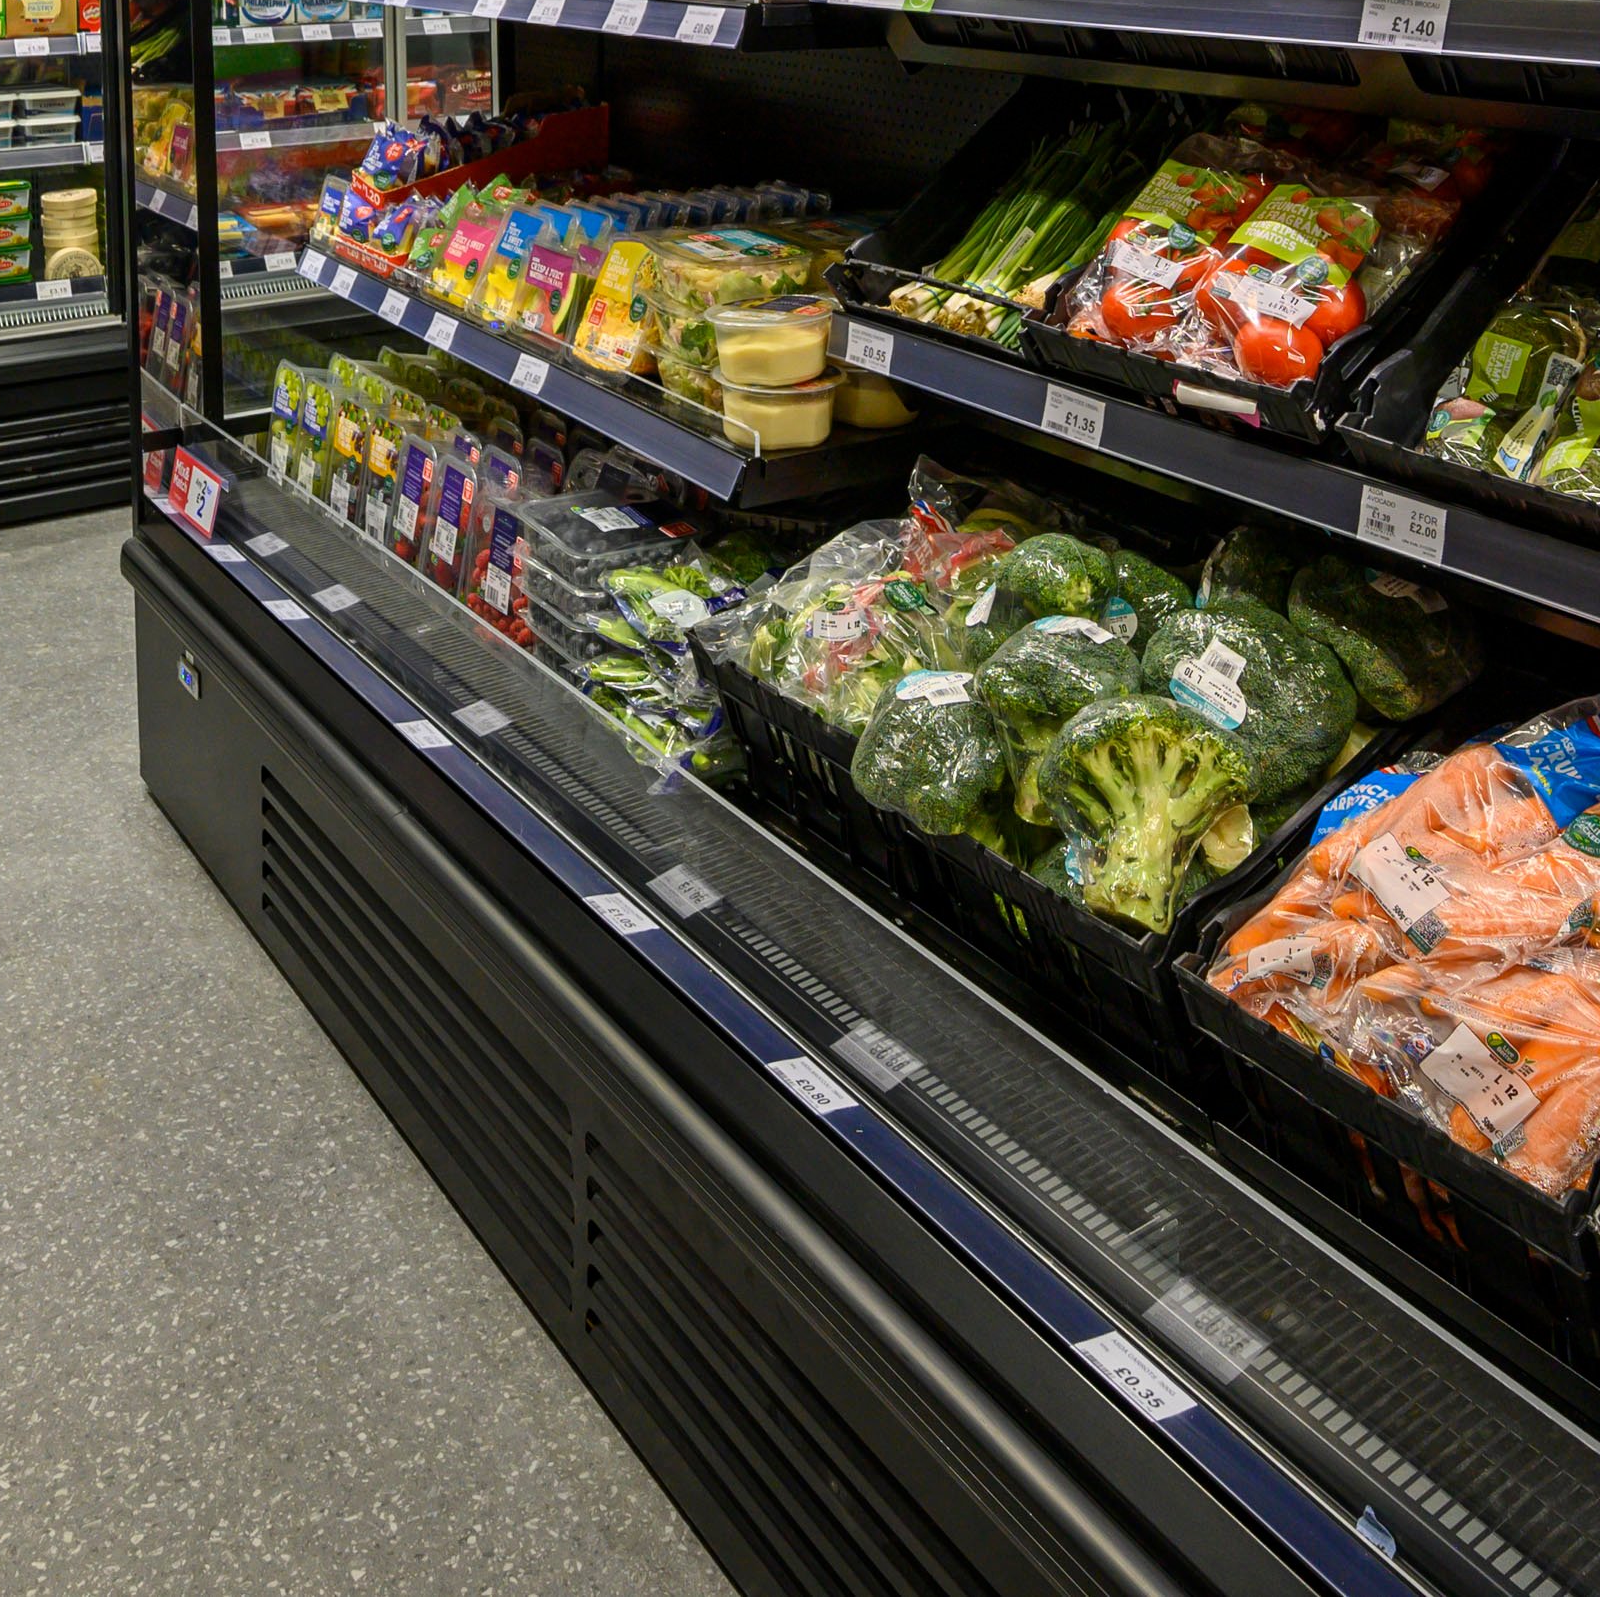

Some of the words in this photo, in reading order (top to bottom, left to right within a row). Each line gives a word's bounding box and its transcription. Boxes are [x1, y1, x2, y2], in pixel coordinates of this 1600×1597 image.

[1392, 17, 1435, 36] £1.40
[863, 345, 886, 362] £0.55
[1065, 411, 1095, 434] £1.35
[1367, 495, 1396, 508] AVOCADO
[1411, 511, 1417, 520] 2
[1419, 513, 1437, 526] FOR
[1410, 523, 1436, 539] £2.00
[607, 907, 636, 929] £1.05
[796, 1079, 831, 1106] £0.80
[1112, 1367, 1165, 1410] £0.35
